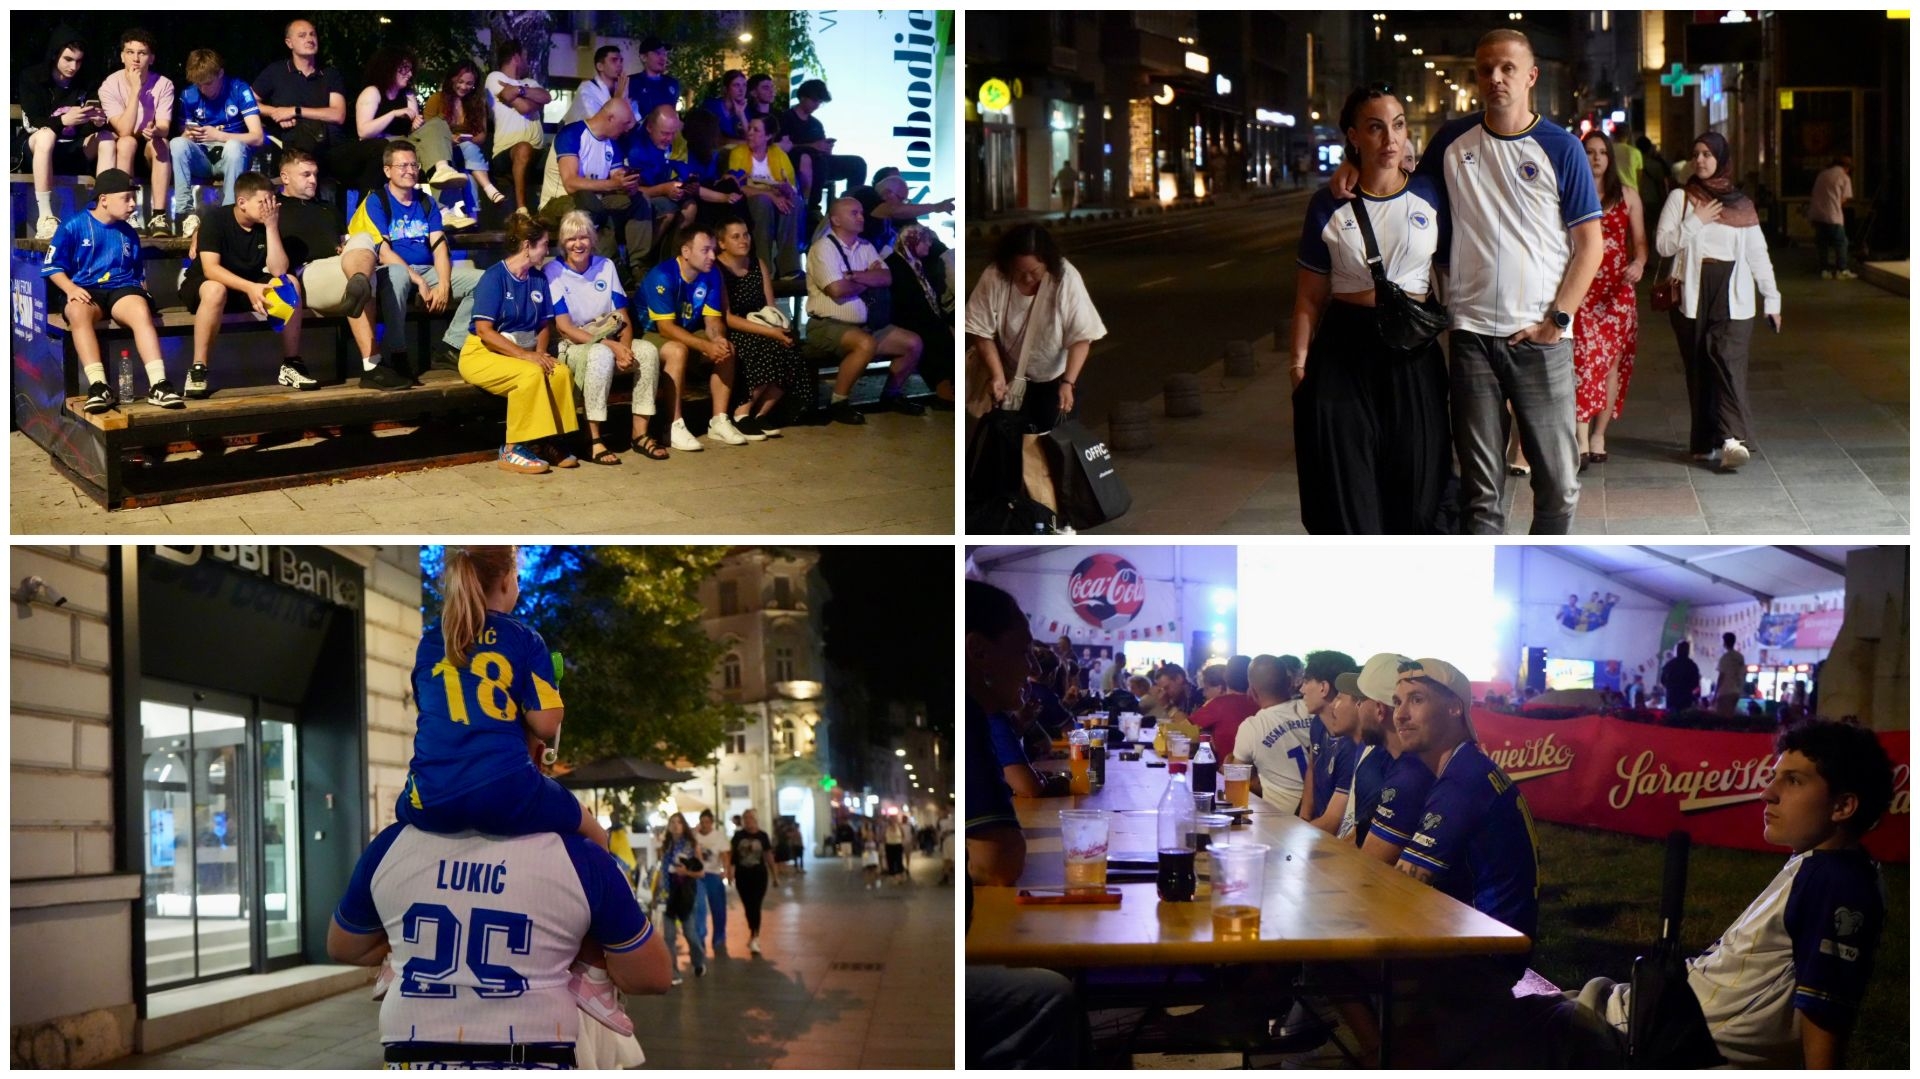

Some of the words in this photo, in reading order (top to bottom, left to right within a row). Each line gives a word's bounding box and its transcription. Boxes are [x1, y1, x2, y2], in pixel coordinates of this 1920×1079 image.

[1084, 442, 1108, 461] OFFIC
[279, 546, 358, 606] Banka
[431, 651, 518, 725] 18
[1262, 725, 1288, 748] BOSNA
[1481, 733, 1576, 769] ajevsko
[1608, 750, 1777, 810] Sarajevsk
[436, 859, 507, 895] LUKIĆ
[400, 902, 534, 999] 25
